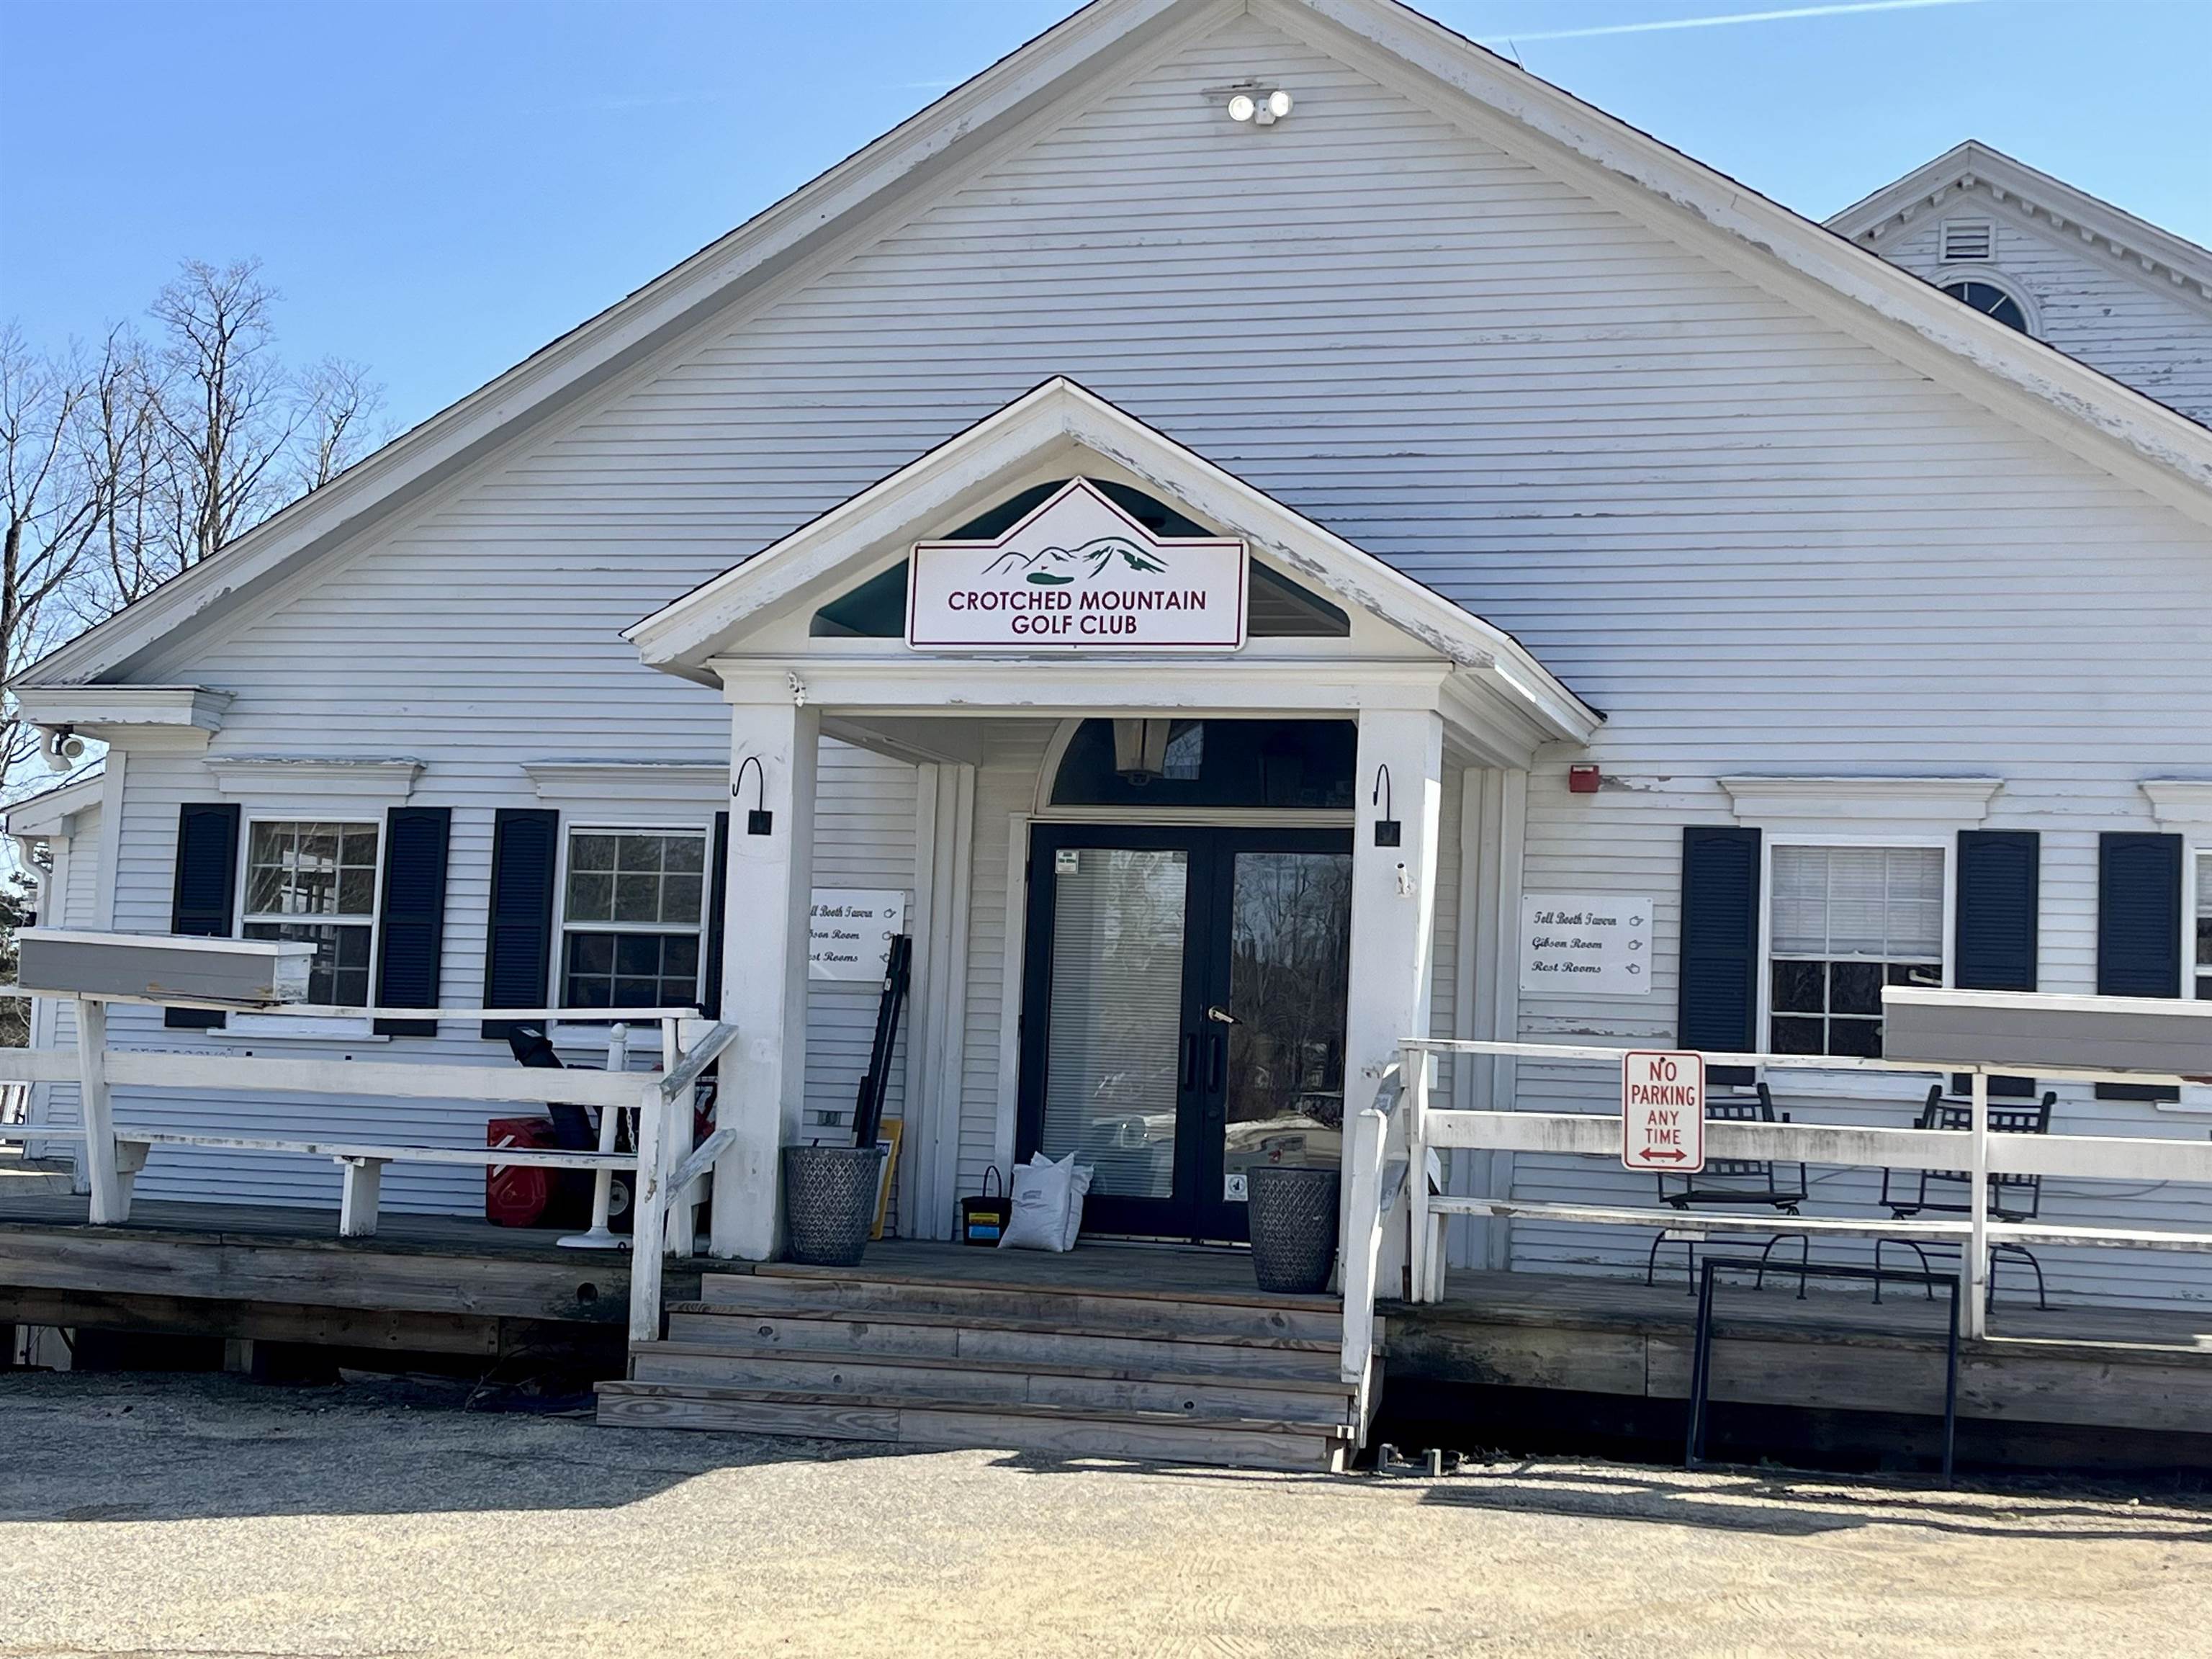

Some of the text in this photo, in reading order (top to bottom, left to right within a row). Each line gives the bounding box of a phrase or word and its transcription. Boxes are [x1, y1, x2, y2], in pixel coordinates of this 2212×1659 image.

[948, 590, 1207, 611] CROTCHED MOUNTAIN
[1011, 615, 1138, 634] GOLF CLUB
[1585, 912, 1617, 926] Tavern
[832, 929, 860, 940] Room
[1532, 936, 1602, 950] Gibson Room
[823, 950, 858, 963] Rooms
[1531, 961, 1602, 974] Rest Rooms
[1650, 1061, 1677, 1082] NO
[1631, 1084, 1696, 1107] PARKING
[1647, 1110, 1679, 1126] ANY
[1645, 1128, 1681, 1145] TIME
